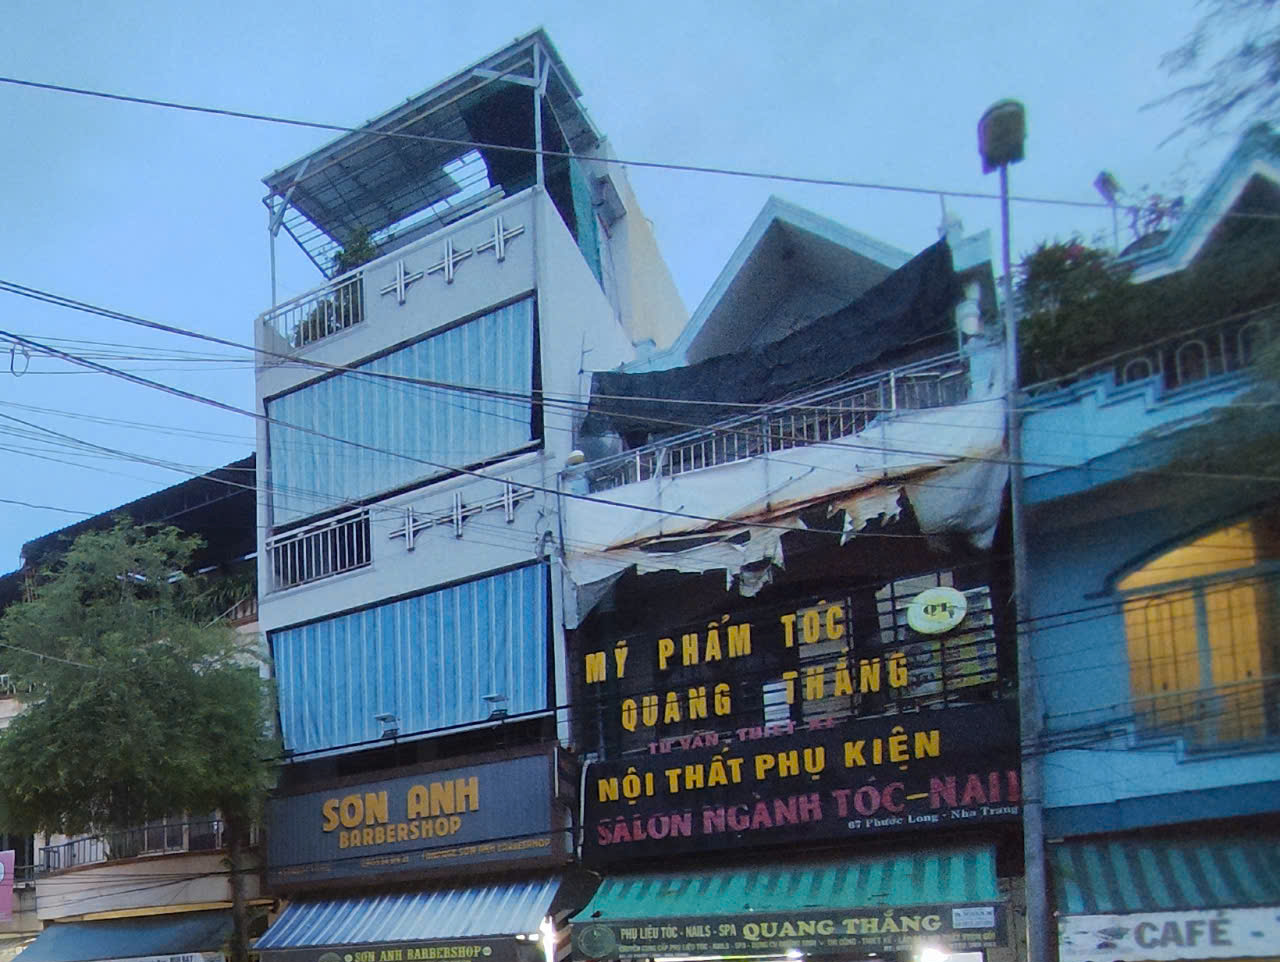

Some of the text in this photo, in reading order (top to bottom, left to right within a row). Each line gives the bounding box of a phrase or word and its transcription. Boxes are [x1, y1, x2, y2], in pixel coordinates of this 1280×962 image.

[585, 599, 845, 684] MỸ PHẨM TÓC
[622, 682, 732, 732] QUANG
[598, 726, 941, 805] NỘI THẤT PHỤ KIỆN
[322, 776, 479, 832] SƠN ANH
[848, 819, 862, 830] 67
[907, 812, 939, 824] Long
[951, 808, 976, 820] Nha
[980, 805, 1019, 817] Trang
[339, 816, 462, 849] BARBERSHOP
[596, 811, 693, 846] SALON
[685, 925, 711, 938] NAILS
[718, 924, 737, 937] SPA
[742, 919, 835, 941] QUANG
[842, 908, 943, 934] THẮNG
[1133, 910, 1233, 950] CAFÉ
[380, 949, 403, 962] ANH
[407, 946, 481, 960] BARBERSHOP
